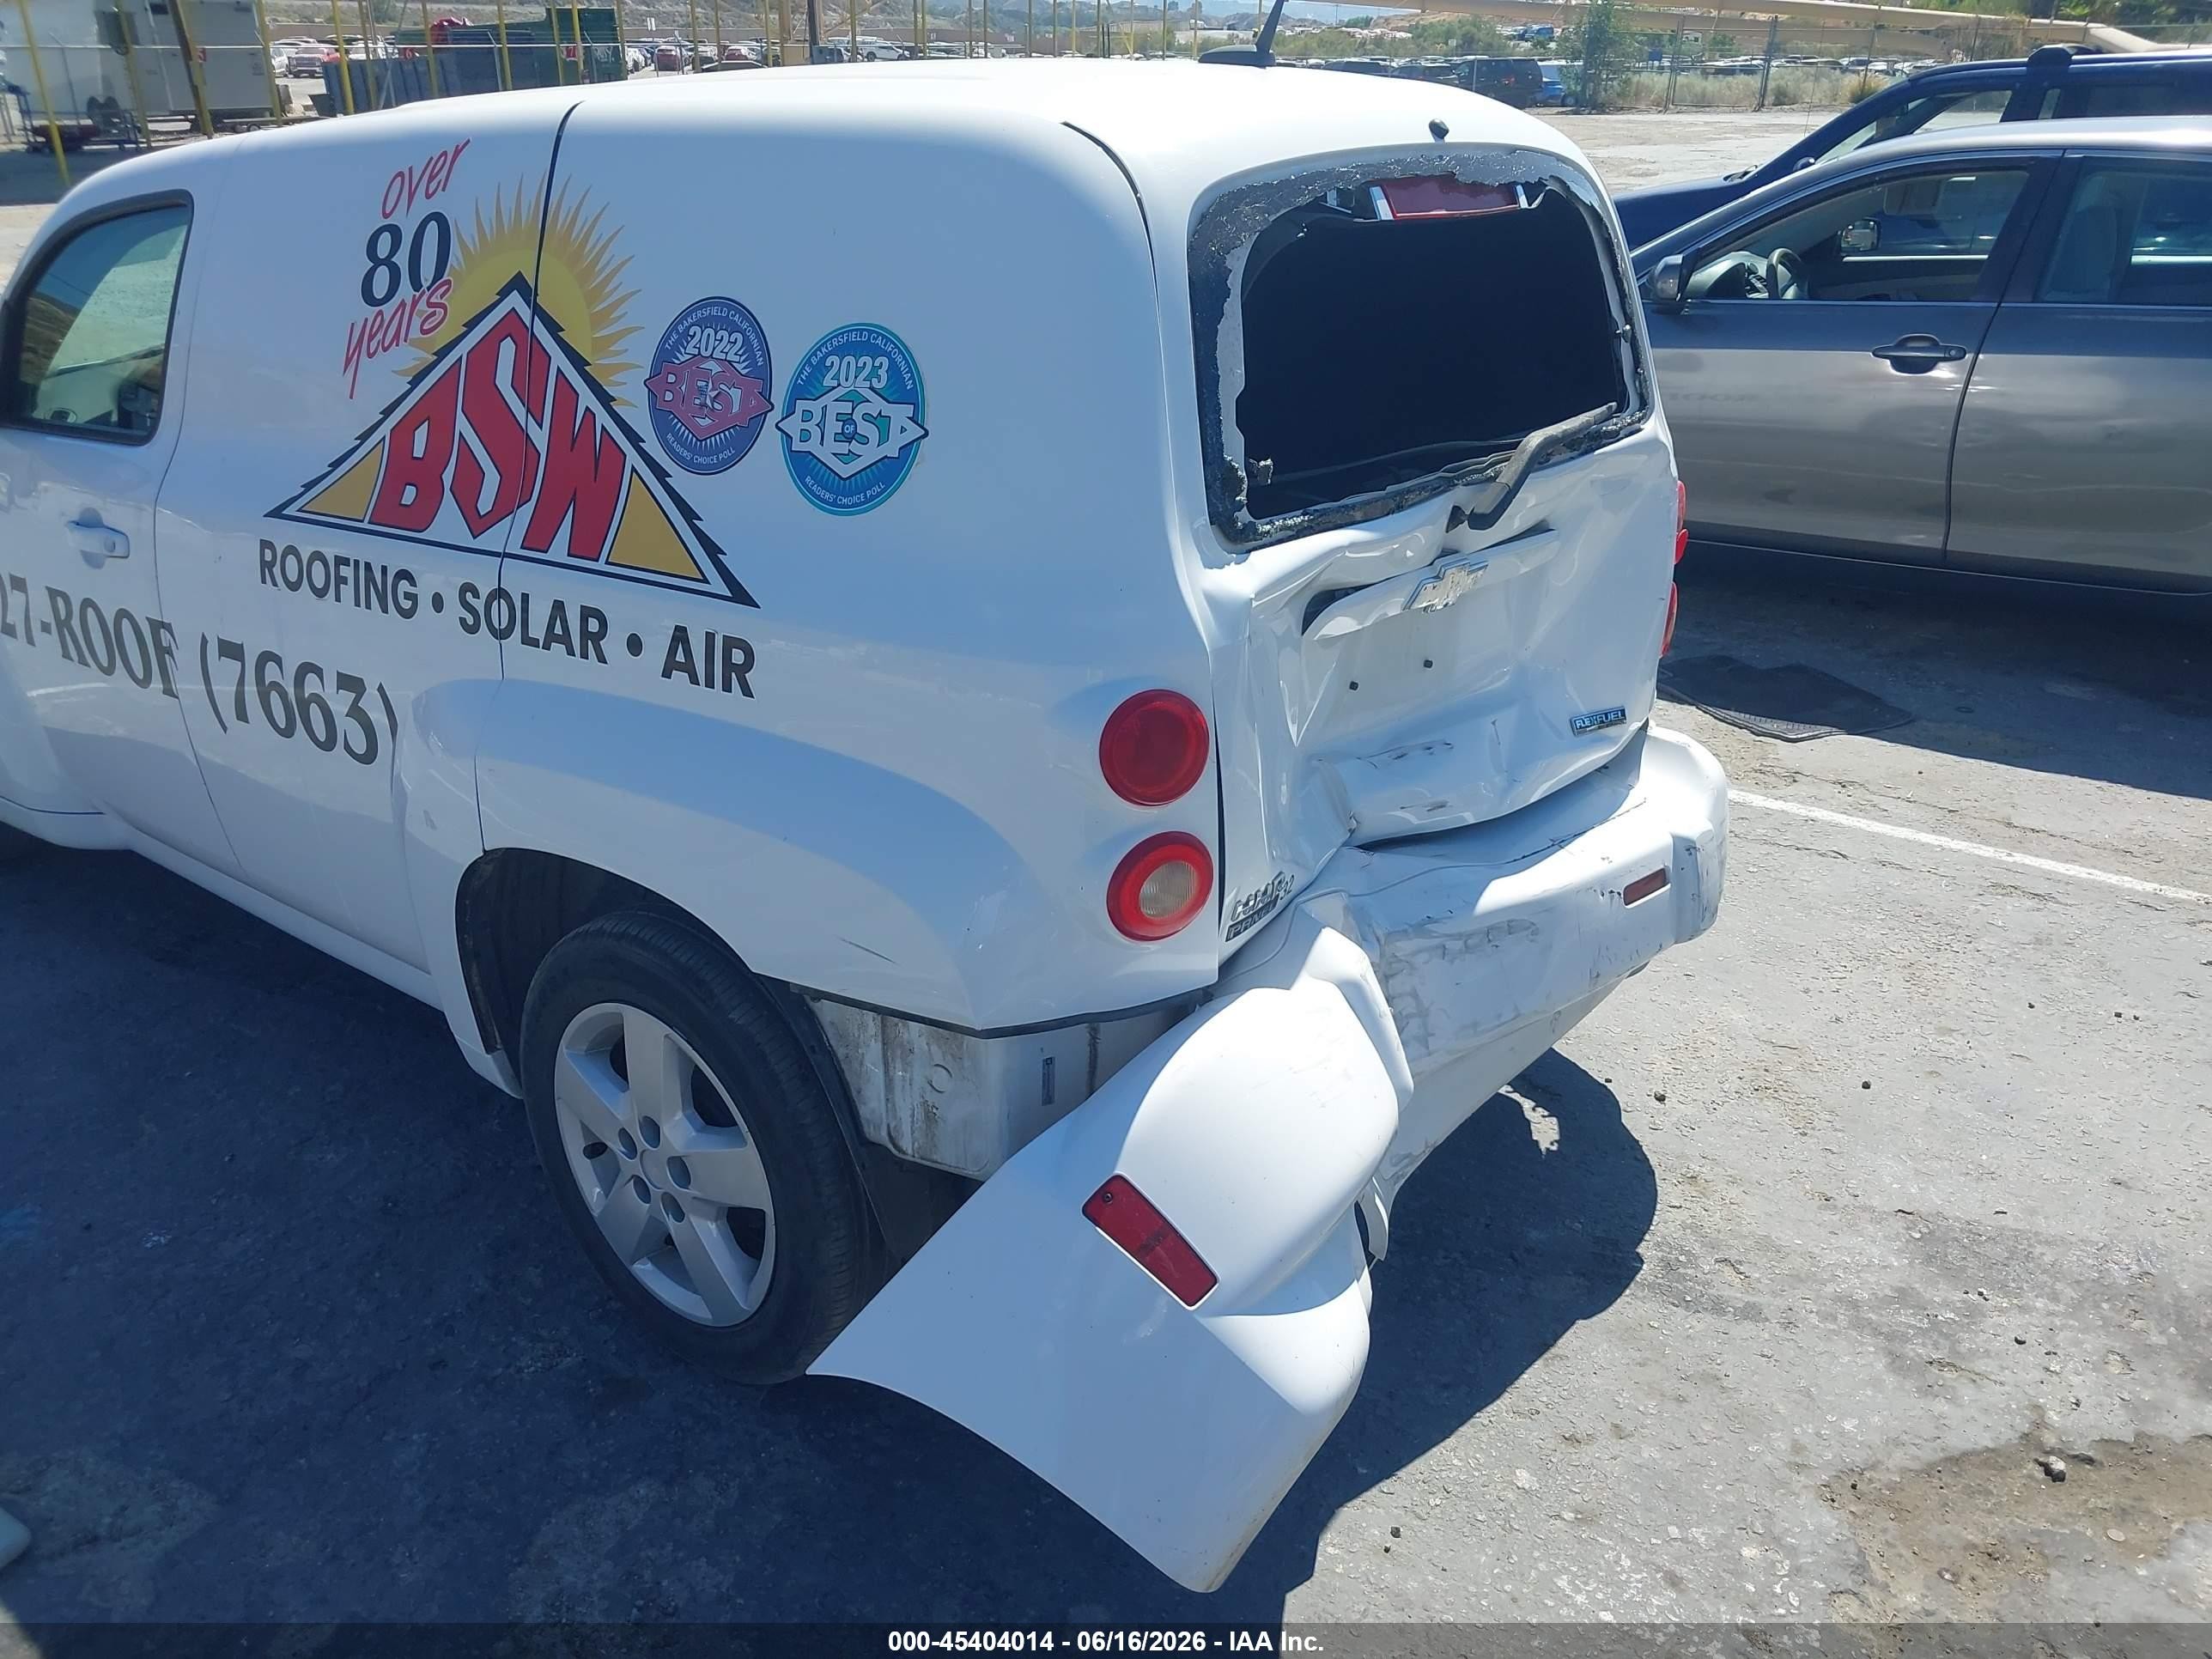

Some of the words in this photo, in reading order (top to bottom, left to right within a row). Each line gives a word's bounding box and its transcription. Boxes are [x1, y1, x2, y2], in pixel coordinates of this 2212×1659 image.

[381, 138, 471, 220] over
[361, 211, 452, 307] 80
[343, 277, 453, 399] years
[665, 332, 679, 350] THE
[678, 306, 728, 332] BAKERSFIELD
[728, 310, 764, 367] CALIFORNIAN
[685, 325, 744, 362] 2022
[797, 364, 812, 386] THE
[811, 331, 868, 366] BAKERSFIELD
[870, 333, 915, 391] CALIFORNIAN
[655, 362, 763, 428] BEST
[823, 355, 890, 389] 2023
[368, 307, 627, 562] BSW
[693, 454, 718, 465] CHOICE
[719, 447, 736, 462] POLL
[791, 399, 915, 459] BEST
[843, 424, 856, 434] OF
[836, 494, 866, 505] CHOICE
[866, 482, 885, 498] POLL
[259, 538, 419, 620] ROOFING
[458, 580, 609, 665] SOLAR
[661, 624, 756, 699] AIR
[199, 631, 399, 767] (7663)
